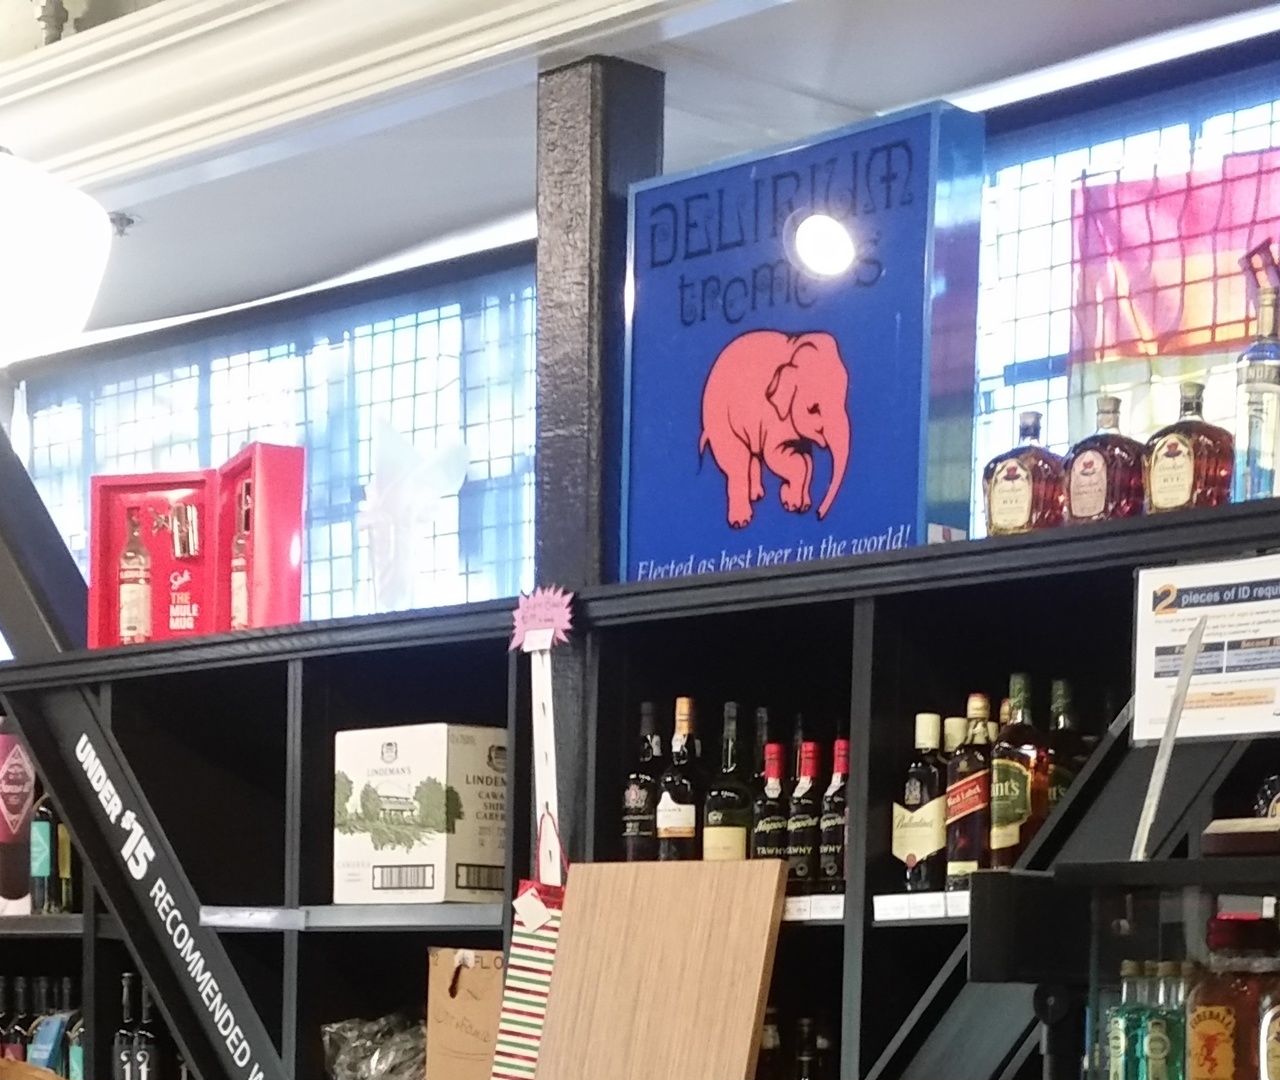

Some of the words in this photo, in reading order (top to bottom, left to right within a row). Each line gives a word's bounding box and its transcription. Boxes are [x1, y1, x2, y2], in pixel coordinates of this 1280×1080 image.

[696, 558, 715, 574] as
[720, 549, 753, 570] best
[757, 545, 792, 567] beer
[796, 538, 814, 561] in
[820, 535, 847, 559] the
[852, 524, 912, 555] world!
[169, 604, 199, 617] MULE
[1154, 584, 1178, 615] 2
[1180, 589, 1221, 608] pieces
[1222, 587, 1238, 600] of
[1238, 587, 1251, 599] ID
[169, 616, 195, 630] MUG
[73, 733, 122, 825] UNDER
[119, 809, 157, 882] $15
[148, 877, 251, 1069] RECOMMENDED
